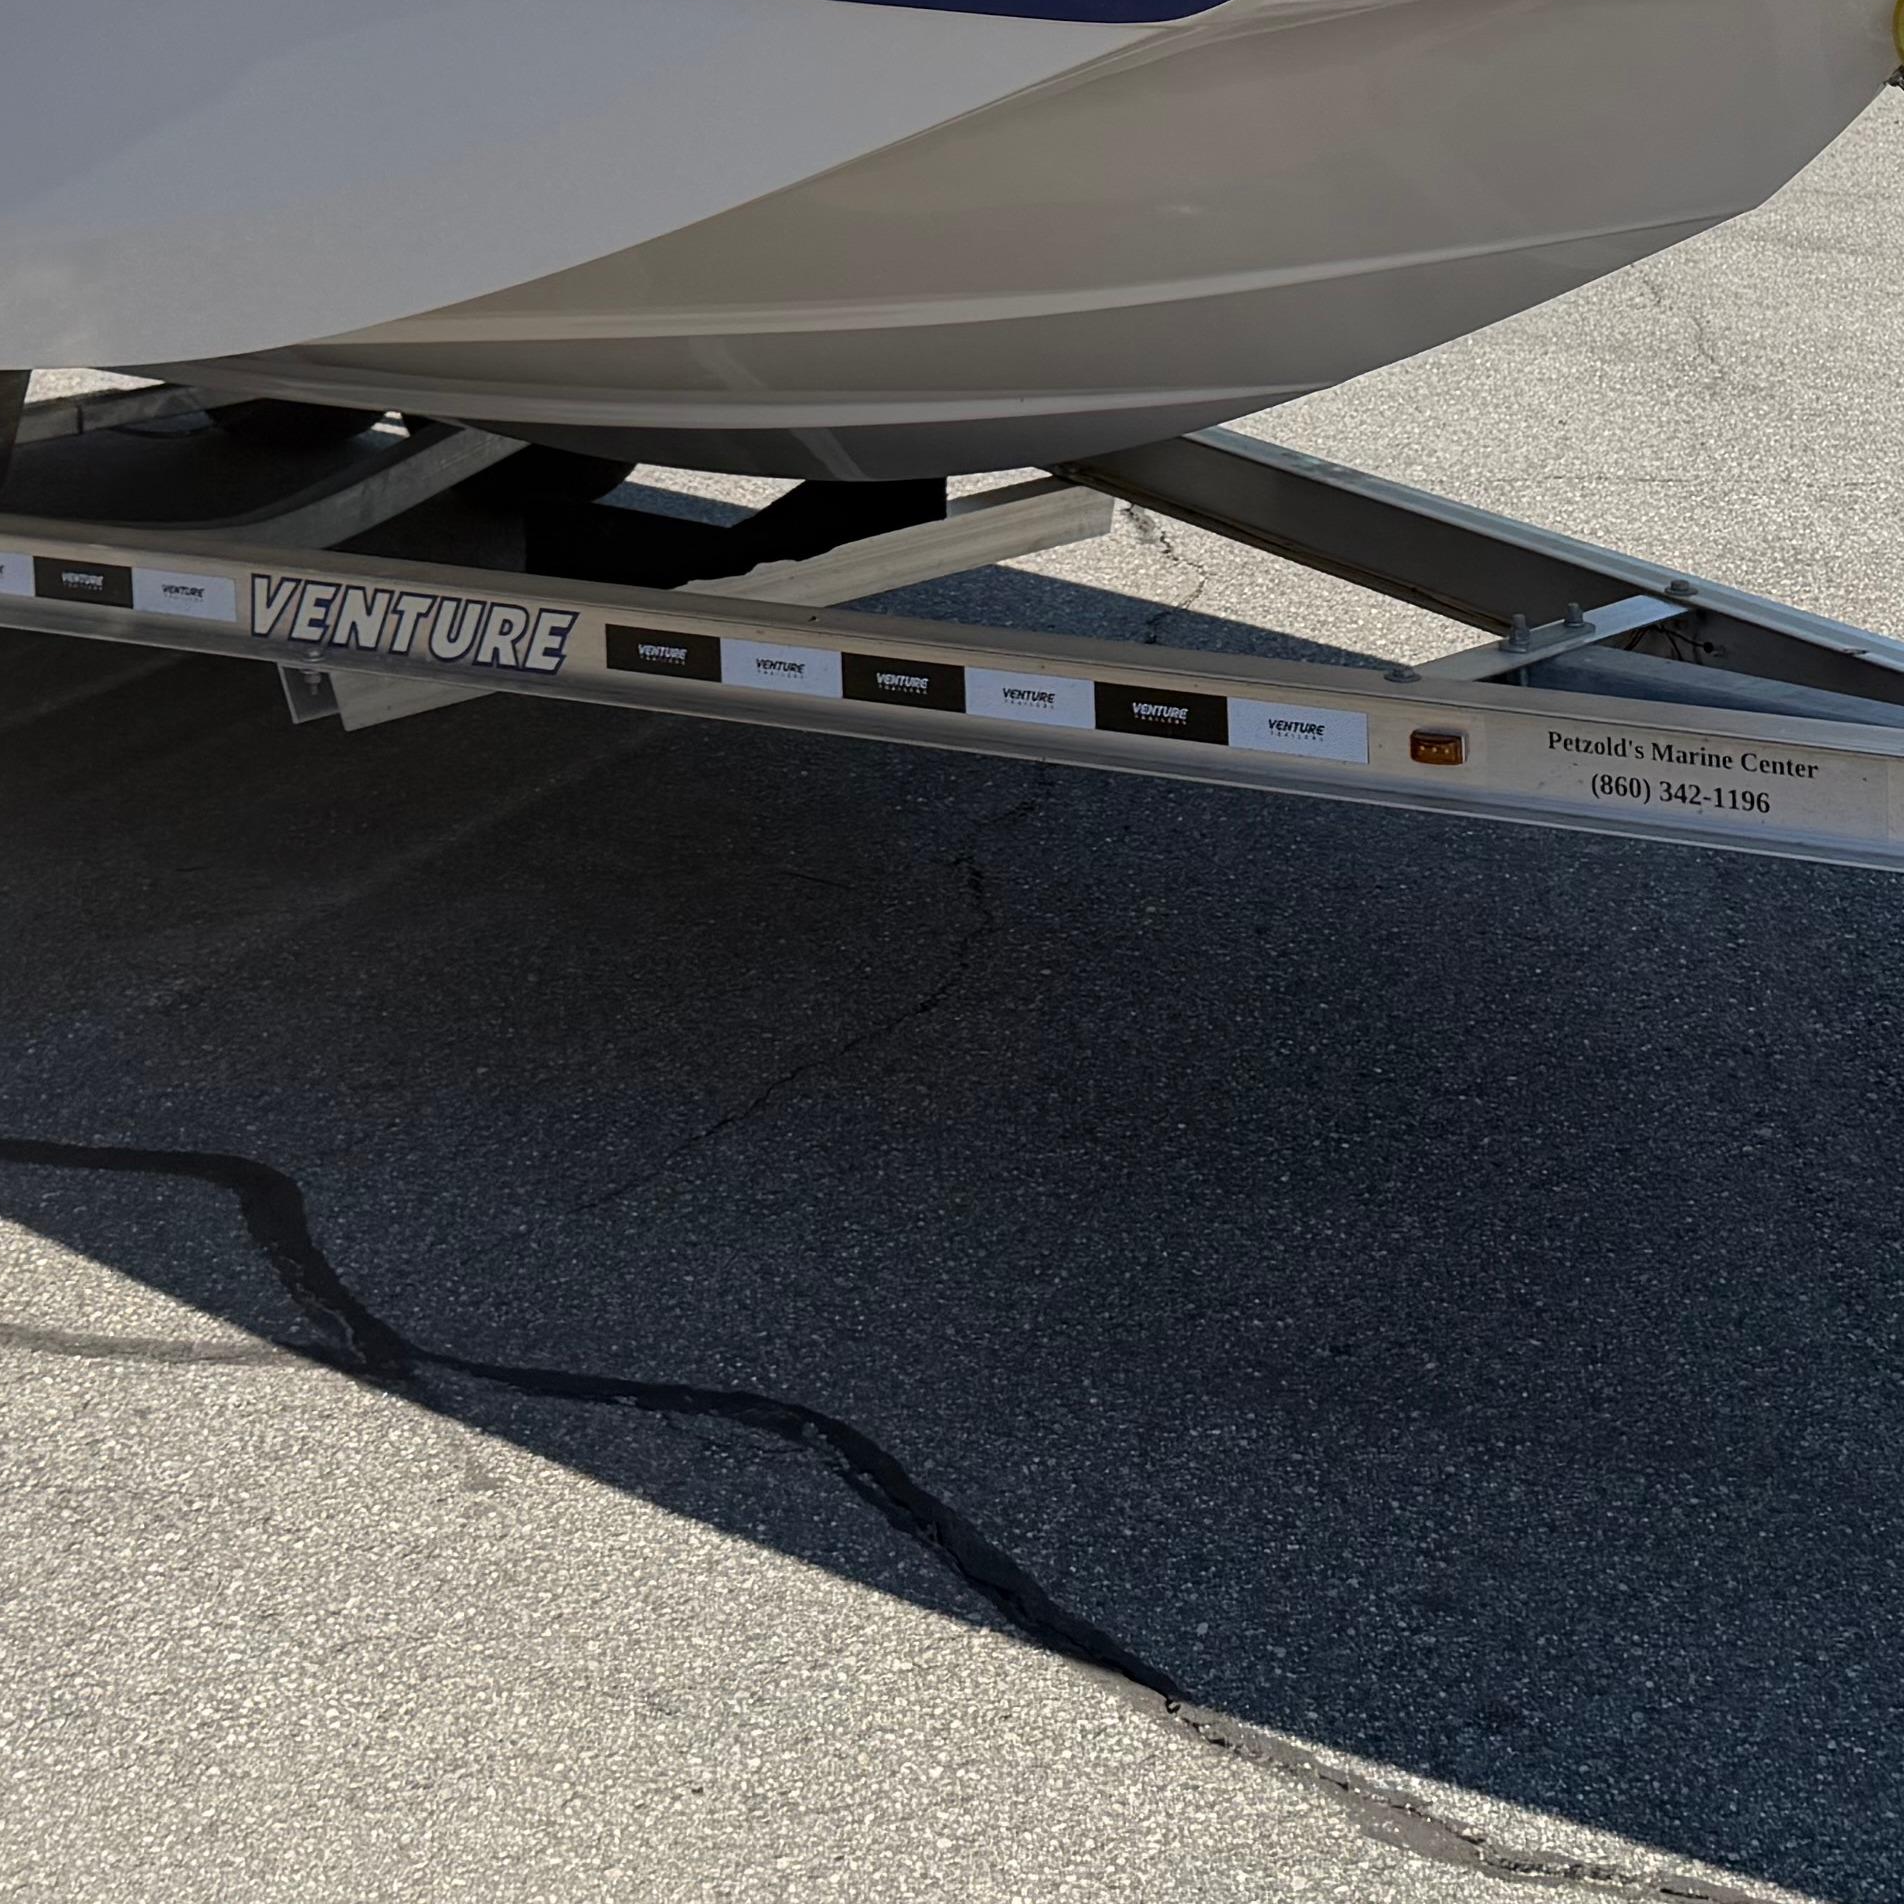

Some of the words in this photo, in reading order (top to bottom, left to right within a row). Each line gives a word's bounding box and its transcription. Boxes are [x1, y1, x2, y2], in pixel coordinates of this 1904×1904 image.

[161, 584, 205, 598] VENTURE
[250, 573, 580, 675] VENTURE
[637, 643, 687, 661] VENTURE
[755, 658, 806, 674] VENTURE
[876, 672, 929, 689] VENTURE
[1002, 687, 1056, 704] VENTURE
[1132, 701, 1189, 720] VENTURE
[1268, 718, 1325, 736] VENTURE
[1547, 730, 1645, 761] Petzold's
[1652, 742, 1733, 770] Marine
[1741, 752, 1820, 779] Center
[1591, 773, 1651, 805] (860)
[1658, 780, 1771, 814] 342-1196
